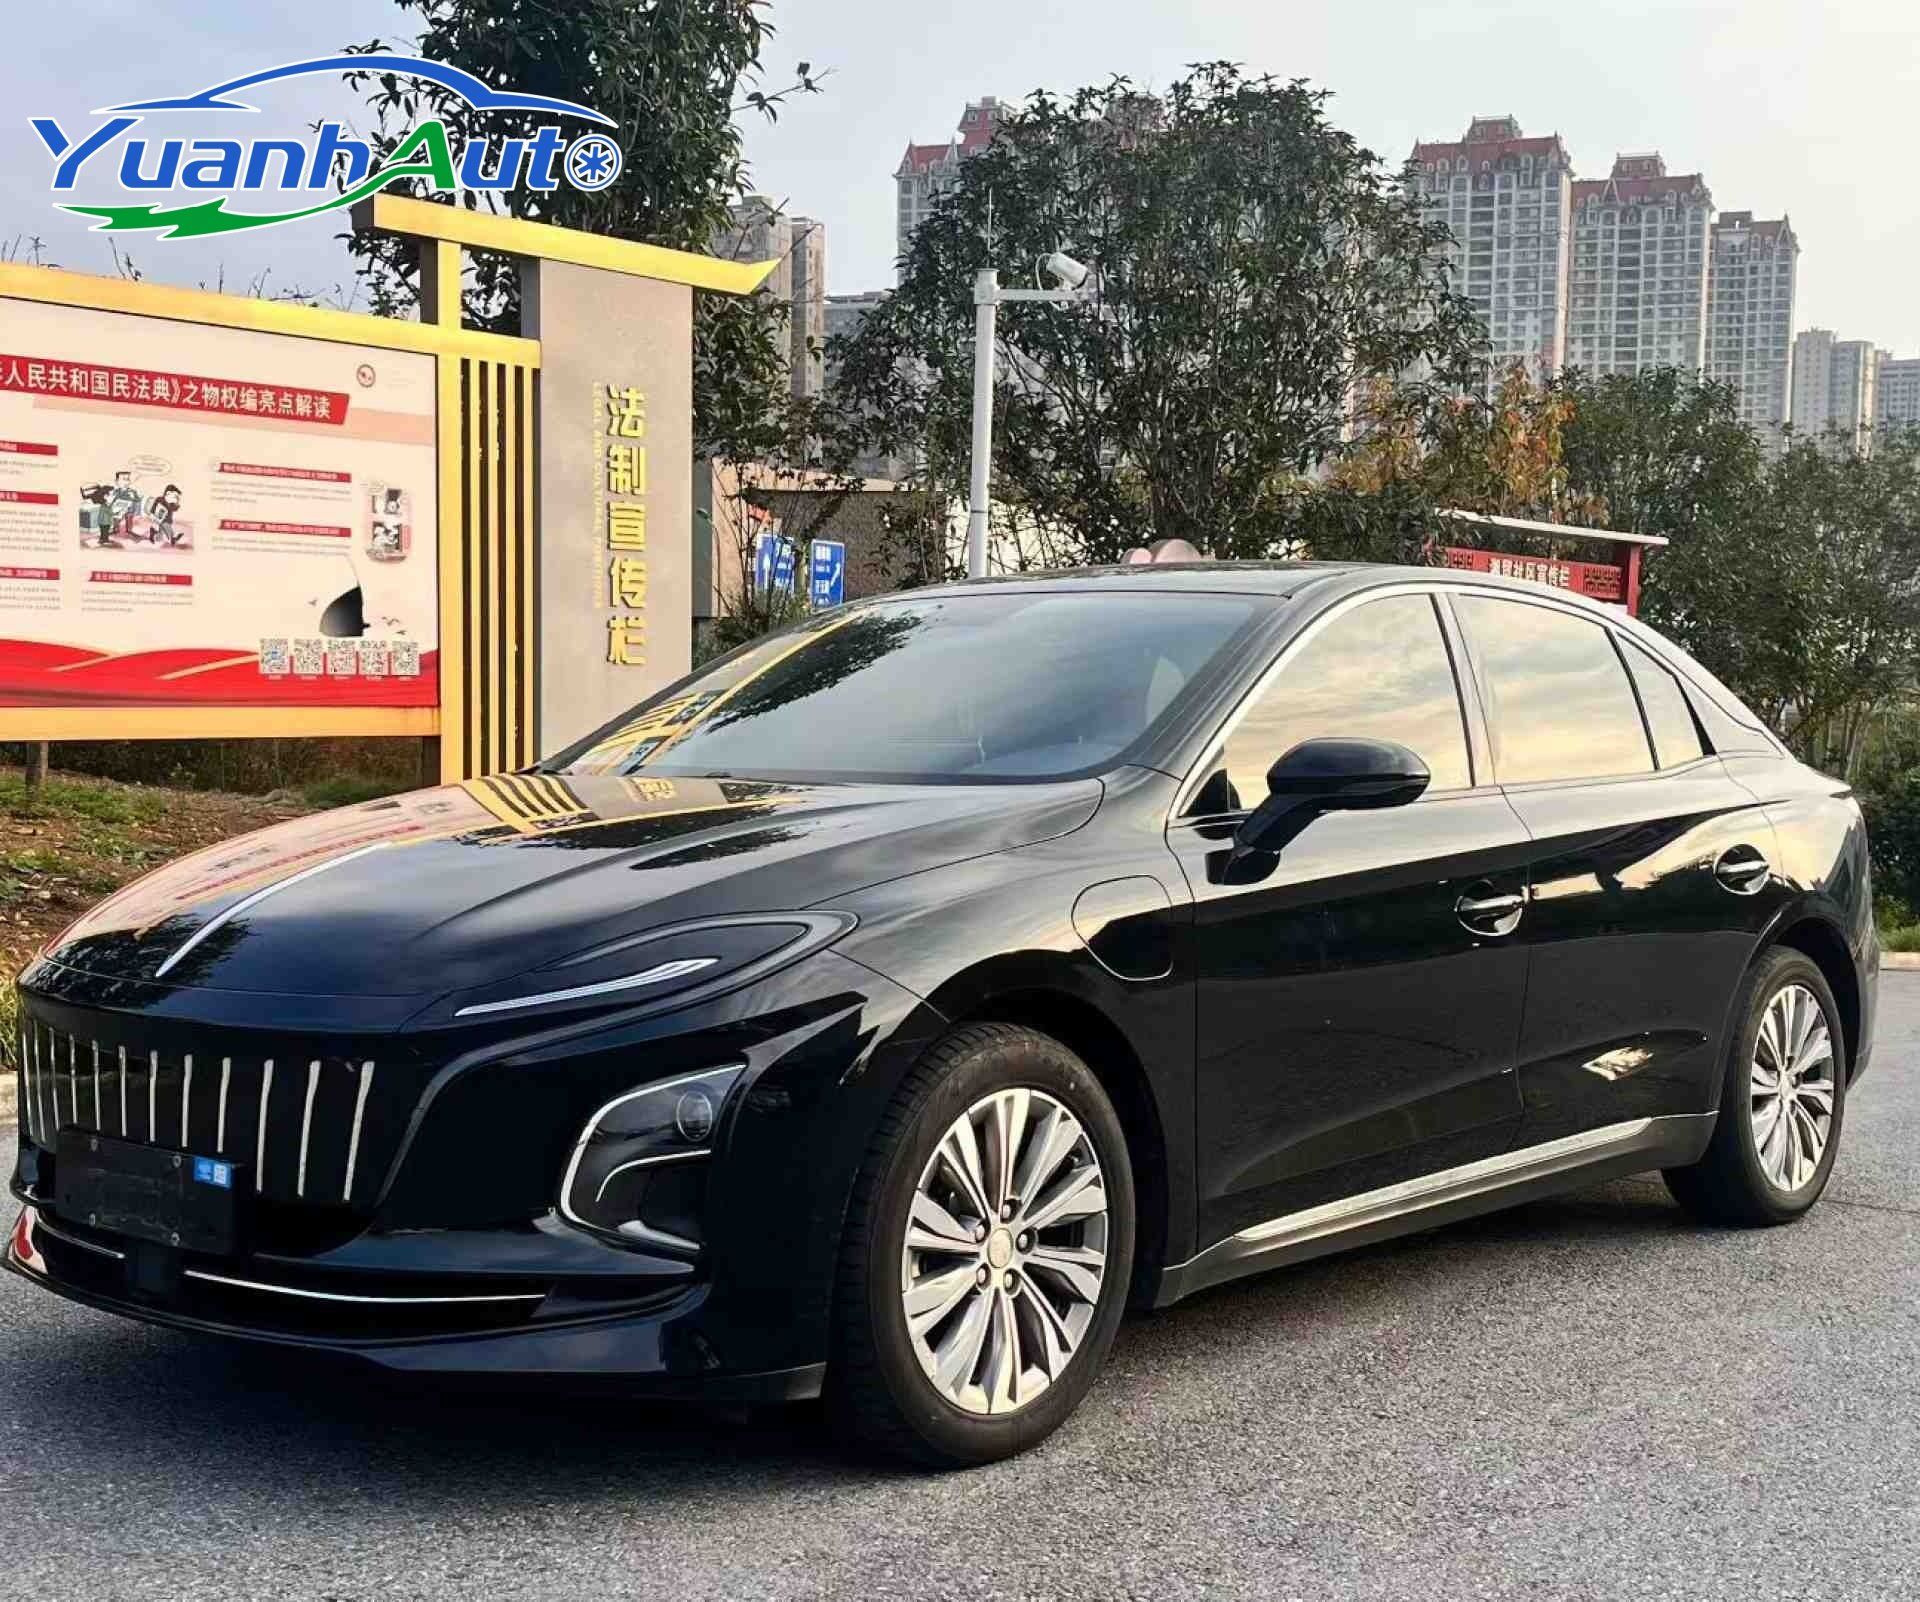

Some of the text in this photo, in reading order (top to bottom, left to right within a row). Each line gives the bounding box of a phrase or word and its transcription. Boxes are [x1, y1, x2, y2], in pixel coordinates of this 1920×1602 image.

[0, 359, 331, 419] 人民共和国民法典》之物权编亮点解读
[607, 383, 646, 665] 法制宣传栏
